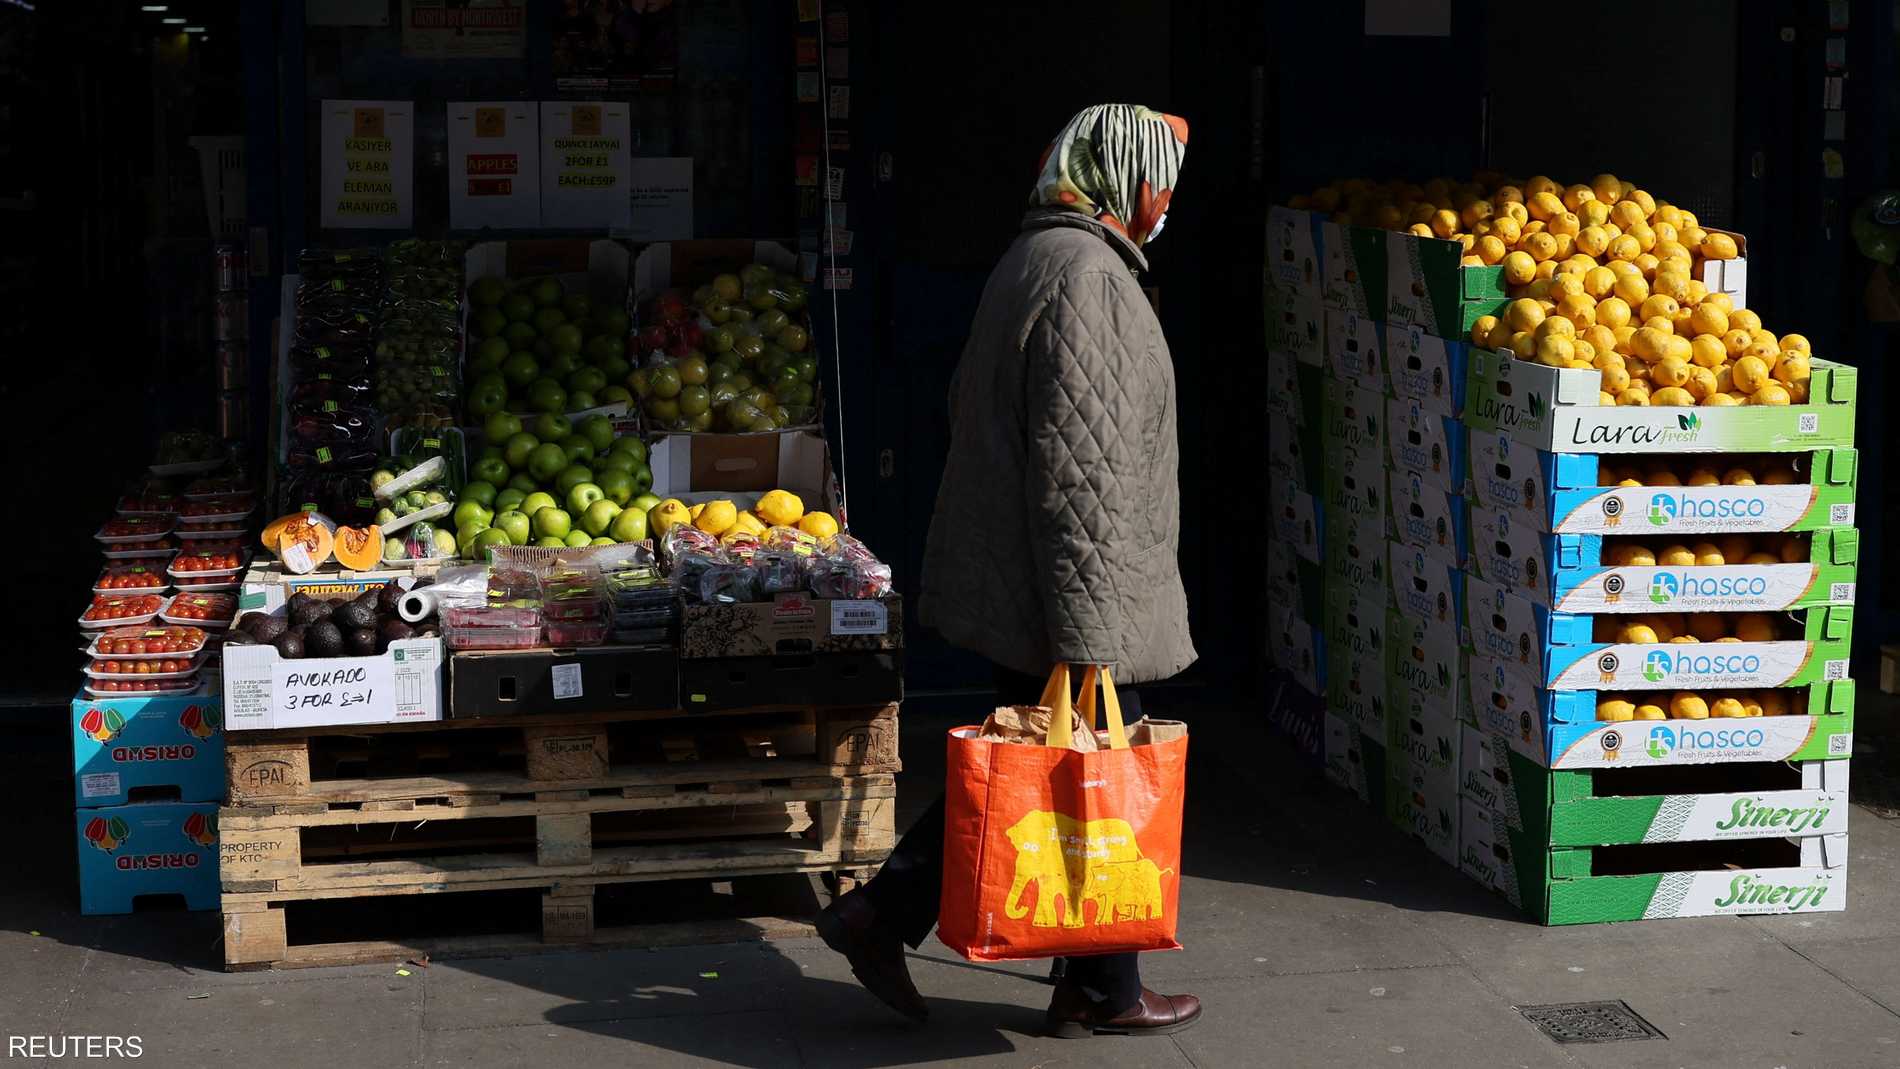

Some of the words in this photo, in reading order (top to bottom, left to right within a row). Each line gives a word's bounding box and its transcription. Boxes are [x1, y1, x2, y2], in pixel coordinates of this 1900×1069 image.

[469, 159, 518, 170] APPLES
[1475, 385, 1521, 427] Lara
[1571, 417, 1662, 445] Lara
[1680, 494, 1765, 518] hasco
[1682, 572, 1767, 597] hasco
[1675, 650, 1760, 674] hasco
[286, 667, 367, 689] AVOKADO
[284, 695, 297, 710] 3
[301, 692, 333, 708] FOR
[1679, 726, 1764, 749] hasco
[1716, 797, 1830, 833] Sinerji
[220, 841, 282, 854] PROPERTY
[222, 855, 234, 864] OF
[240, 854, 262, 863] KTC
[1715, 874, 1829, 911] Sinerji
